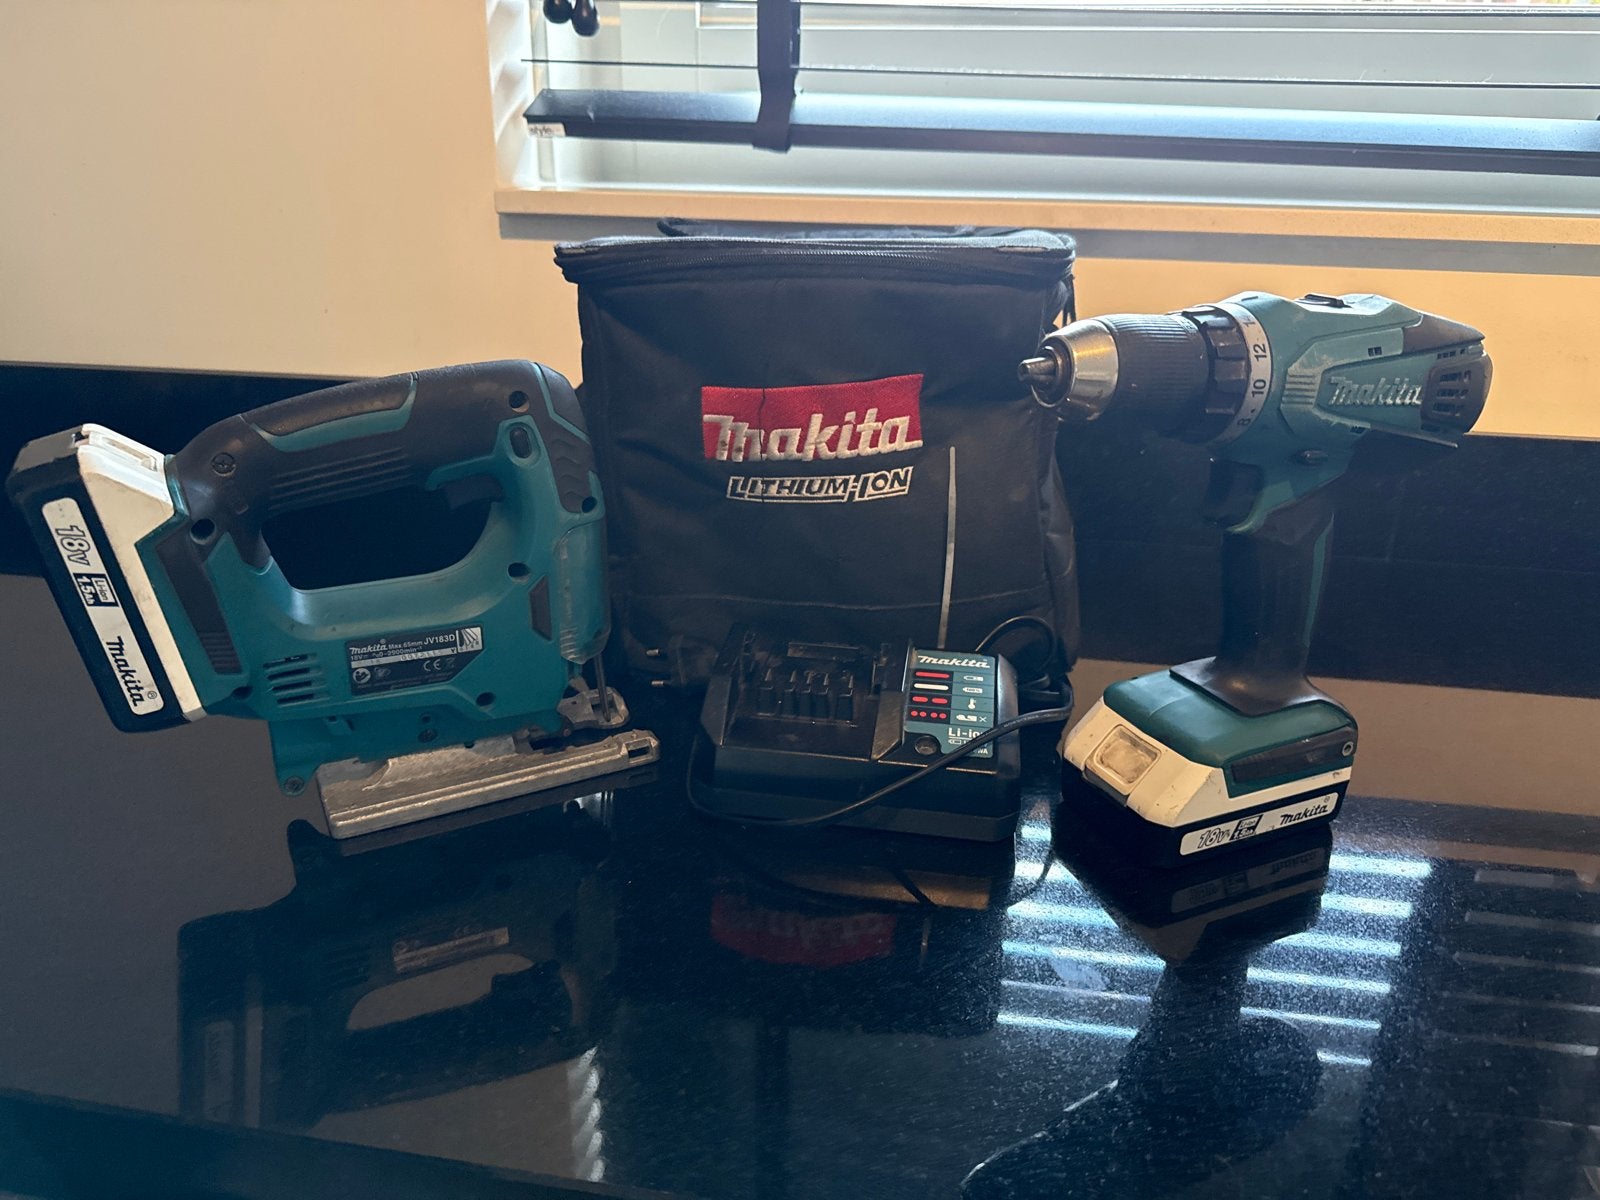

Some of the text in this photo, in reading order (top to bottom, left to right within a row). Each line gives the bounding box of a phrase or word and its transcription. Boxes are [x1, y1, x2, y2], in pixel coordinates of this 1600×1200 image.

[1253, 343, 1268, 362] 12
[1251, 378, 1267, 398] 10
[727, 466, 913, 503] LITHIUM-ION
[423, 633, 456, 645] JV183D
[948, 727, 983, 738] Li-io
